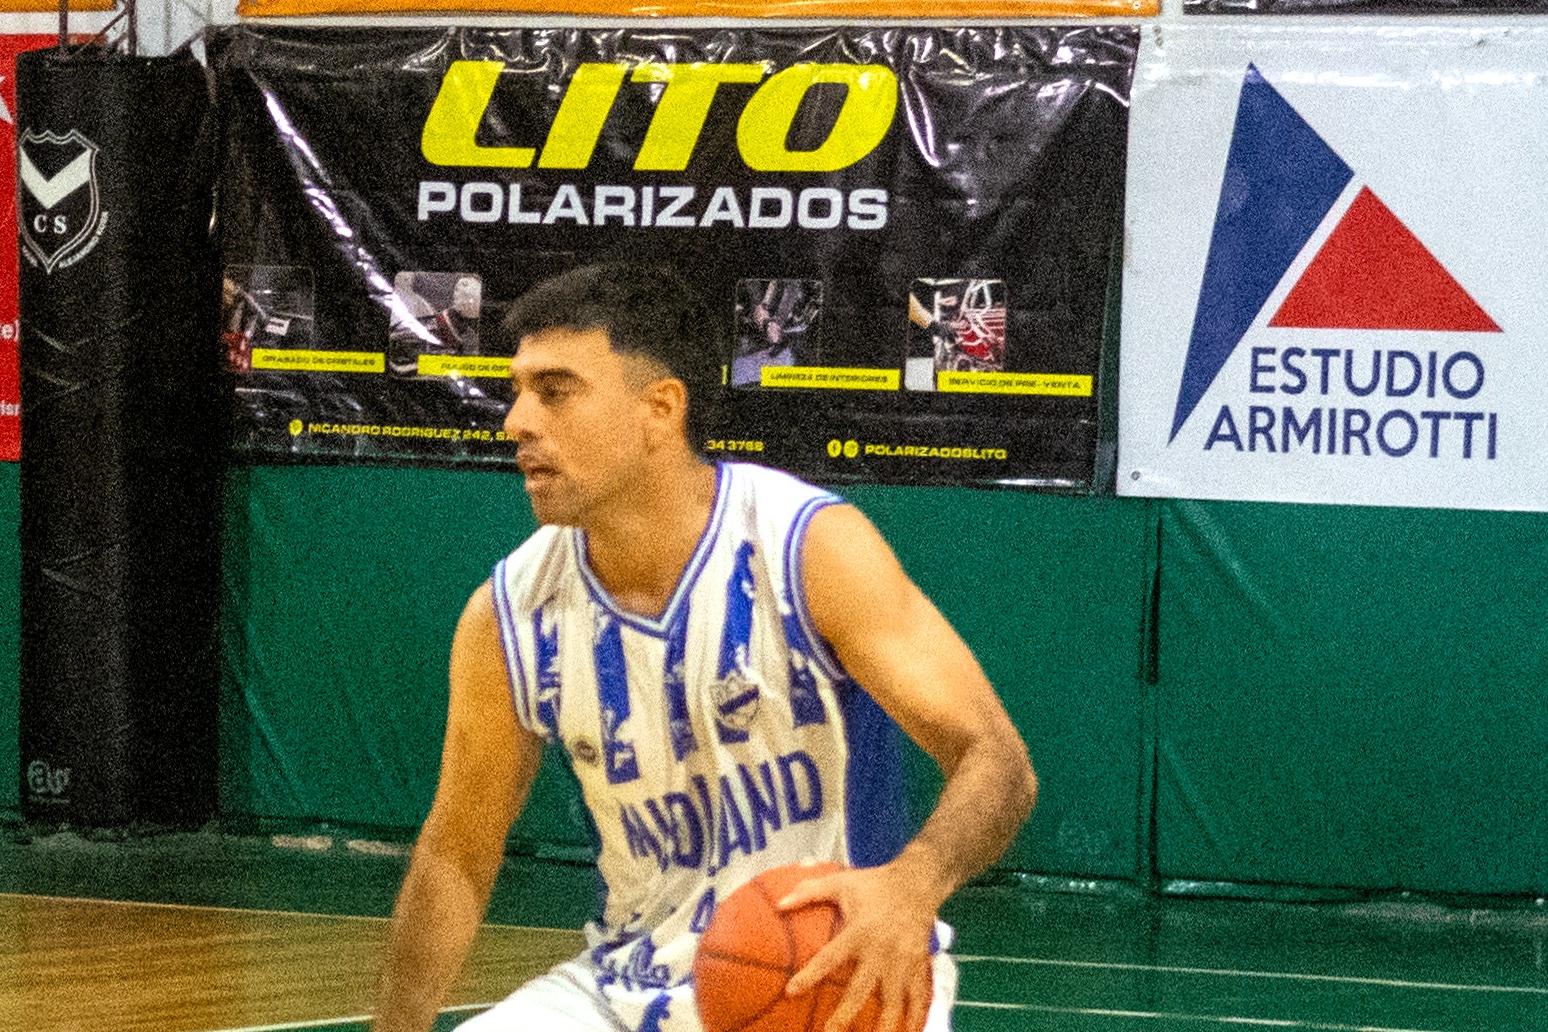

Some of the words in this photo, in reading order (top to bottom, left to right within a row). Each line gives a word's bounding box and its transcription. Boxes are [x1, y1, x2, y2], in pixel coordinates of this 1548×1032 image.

[420, 60, 898, 172] LITO
[417, 181, 889, 230] POLARIZADOS
[1249, 346, 1485, 400] ESTUDIO
[1202, 403, 1498, 460] ARMIROTTI
